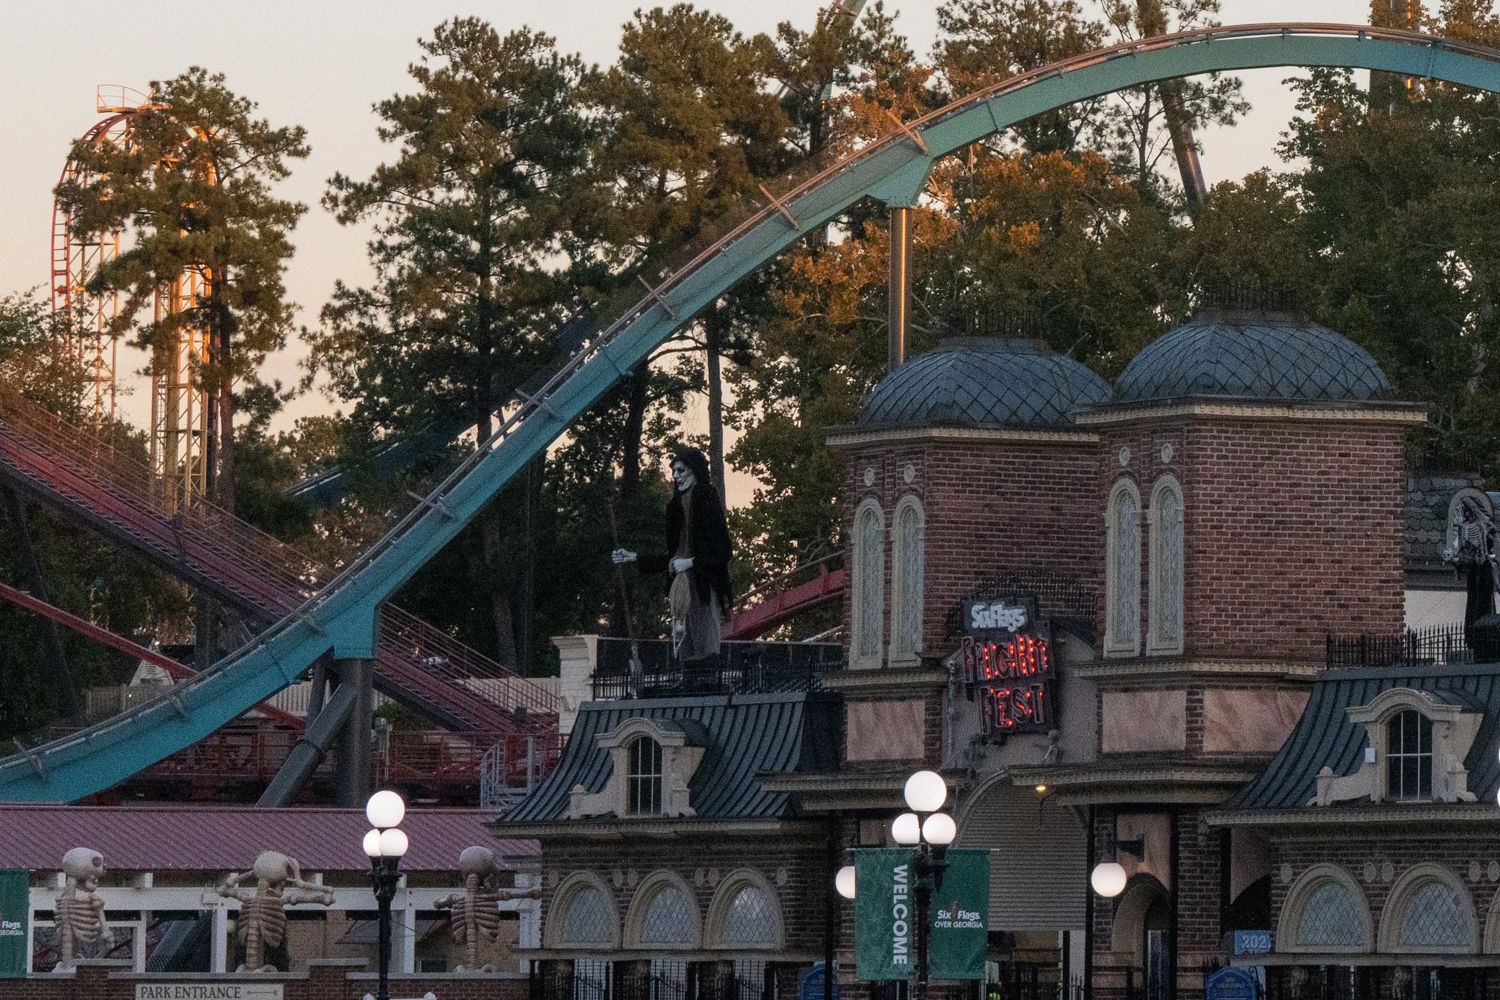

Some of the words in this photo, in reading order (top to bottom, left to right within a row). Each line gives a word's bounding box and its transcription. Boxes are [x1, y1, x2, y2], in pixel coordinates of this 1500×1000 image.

[980, 683, 1045, 734] FEST
[893, 864, 908, 965] WELCOME
[937, 910, 952, 920] Six
[957, 910, 980, 921] Flags
[1, 920, 21, 930] Flags
[934, 921, 952, 929] OVER
[952, 921, 984, 929] GEORGIA
[141, 986, 171, 999] PARK
[174, 986, 242, 999] ENTRANCE
